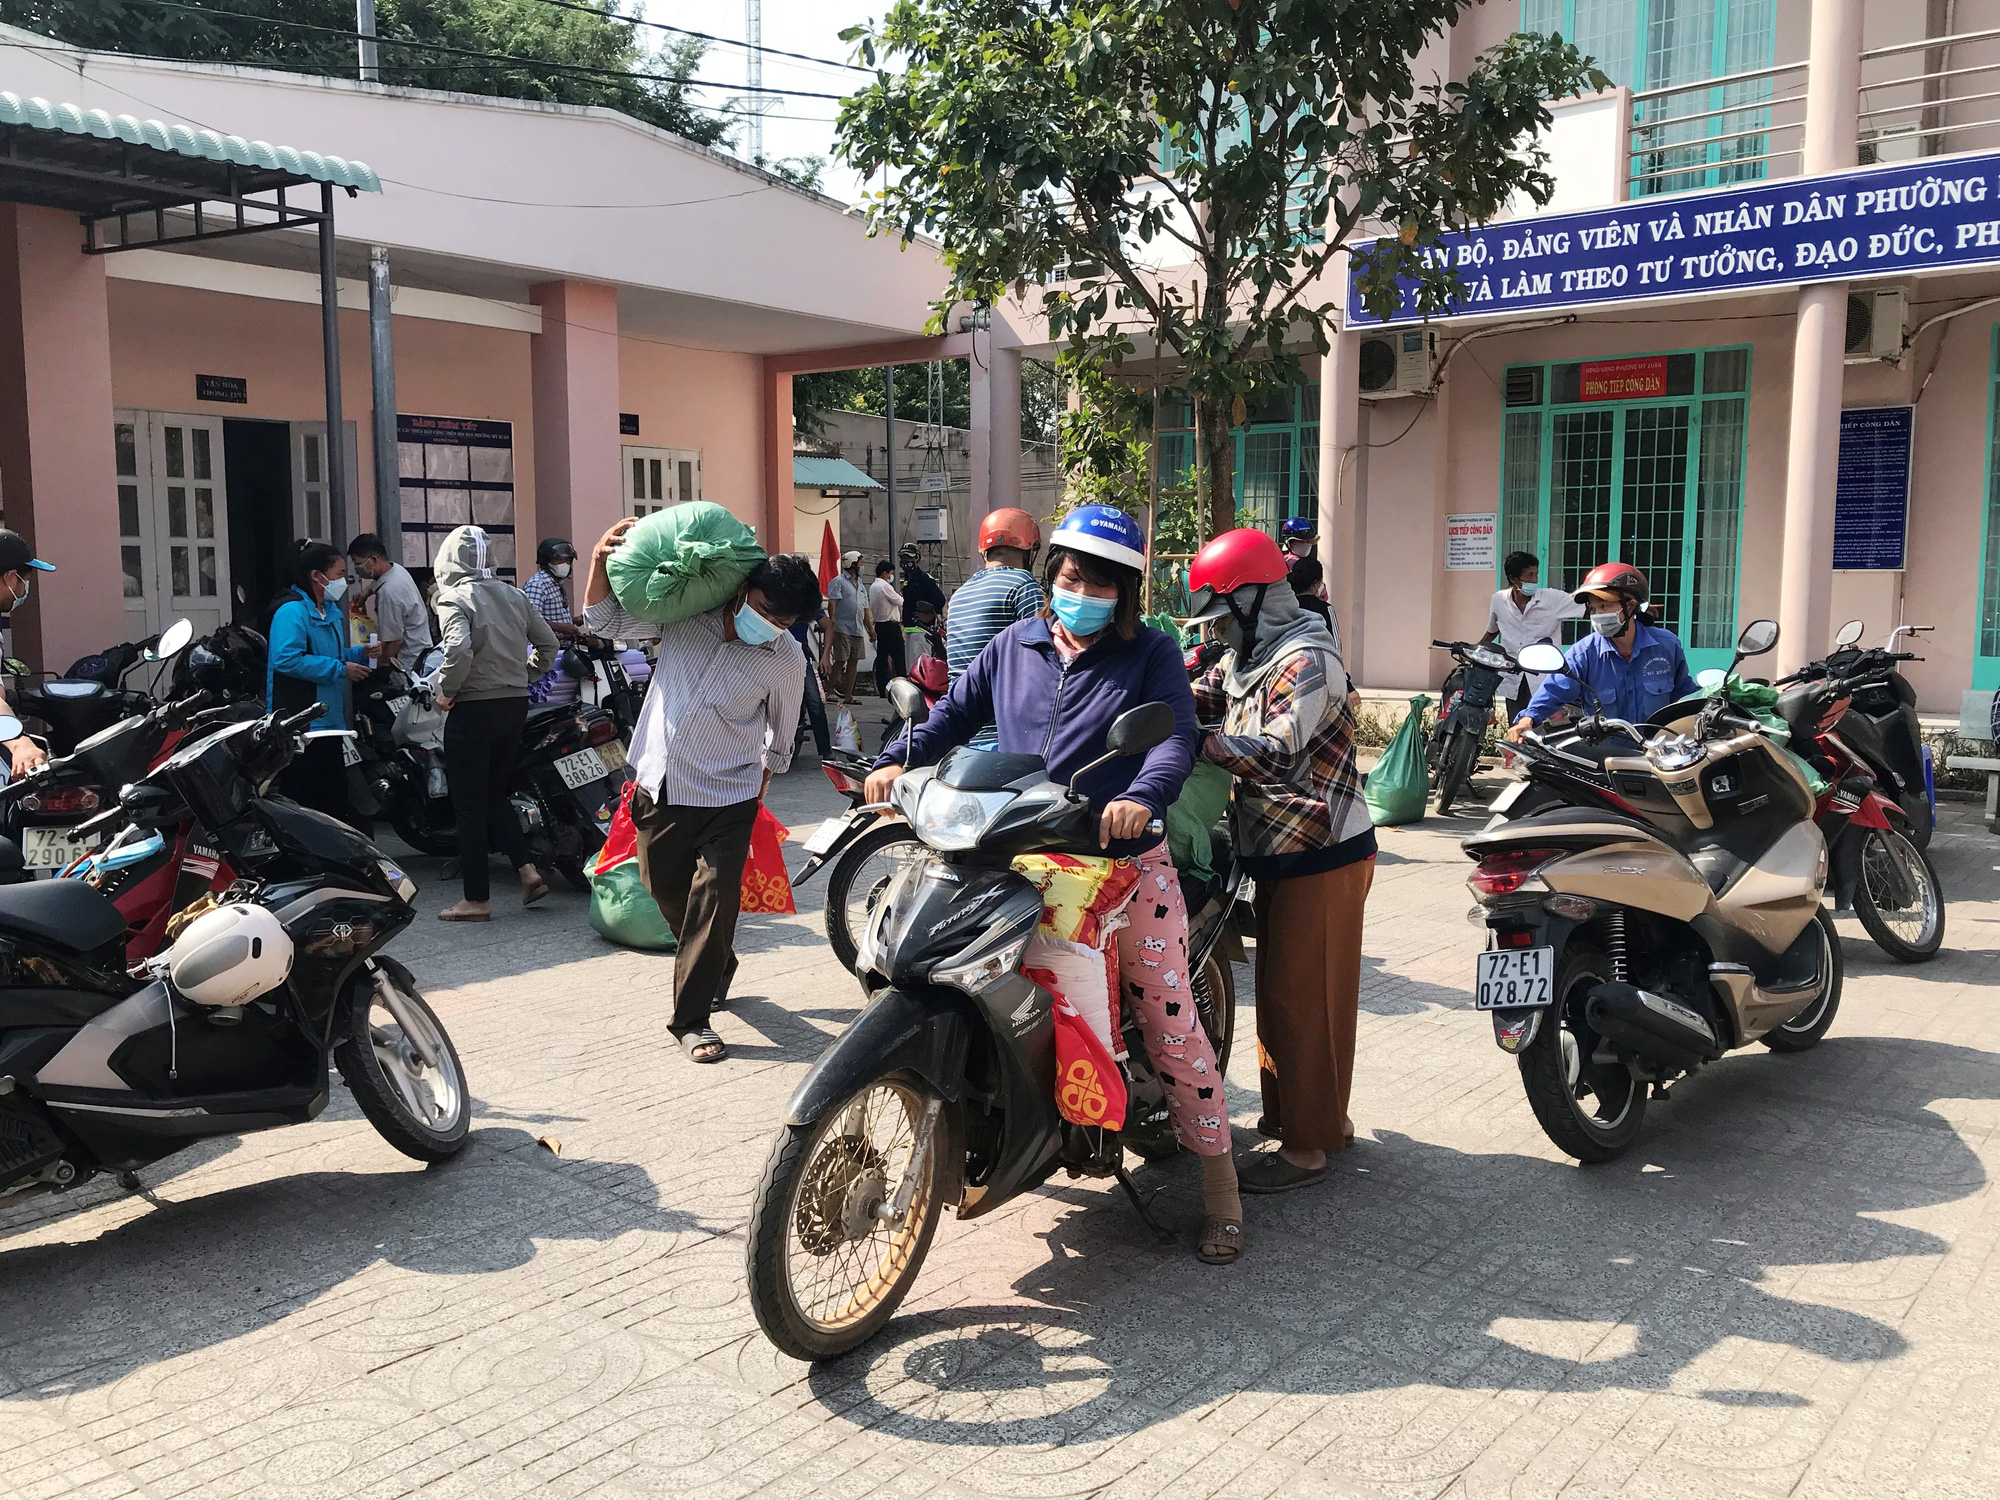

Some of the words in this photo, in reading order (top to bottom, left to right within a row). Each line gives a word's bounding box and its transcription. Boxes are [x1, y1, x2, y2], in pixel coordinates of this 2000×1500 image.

[1456, 237, 1494, 268] BỘ,
[1503, 229, 1571, 261] ĐẢNG
[1578, 220, 1640, 249] VIÊN
[1648, 211, 1685, 241] VÀ
[1693, 201, 1775, 237] NHÂN
[1782, 192, 1847, 225] DÂN
[1855, 176, 1988, 216] PHƯỜNG
[1463, 274, 1494, 302] VÀ
[1500, 270, 1553, 298] LÀM
[1560, 264, 1628, 292] THEO
[1637, 255, 1675, 283] TƯ
[1681, 243, 1784, 280] TƯỞNG,
[1795, 237, 1858, 269] ĐẠO
[1868, 223, 1944, 258] ĐỨC,
[1609, 373, 1625, 394] TIẾP
[1098, 520, 1127, 535] YAMAHA
[561, 752, 593, 773] 72-E1
[565, 763, 604, 786] 388.26
[1840, 789, 1862, 803] YAMAHA
[193, 844, 220, 860] YAMAHA
[1603, 865, 1647, 876] PCX
[1489, 951, 1540, 979] 72-E1
[1480, 977, 1548, 1006] 028.72
[1011, 1008, 1041, 1028] HONDA
